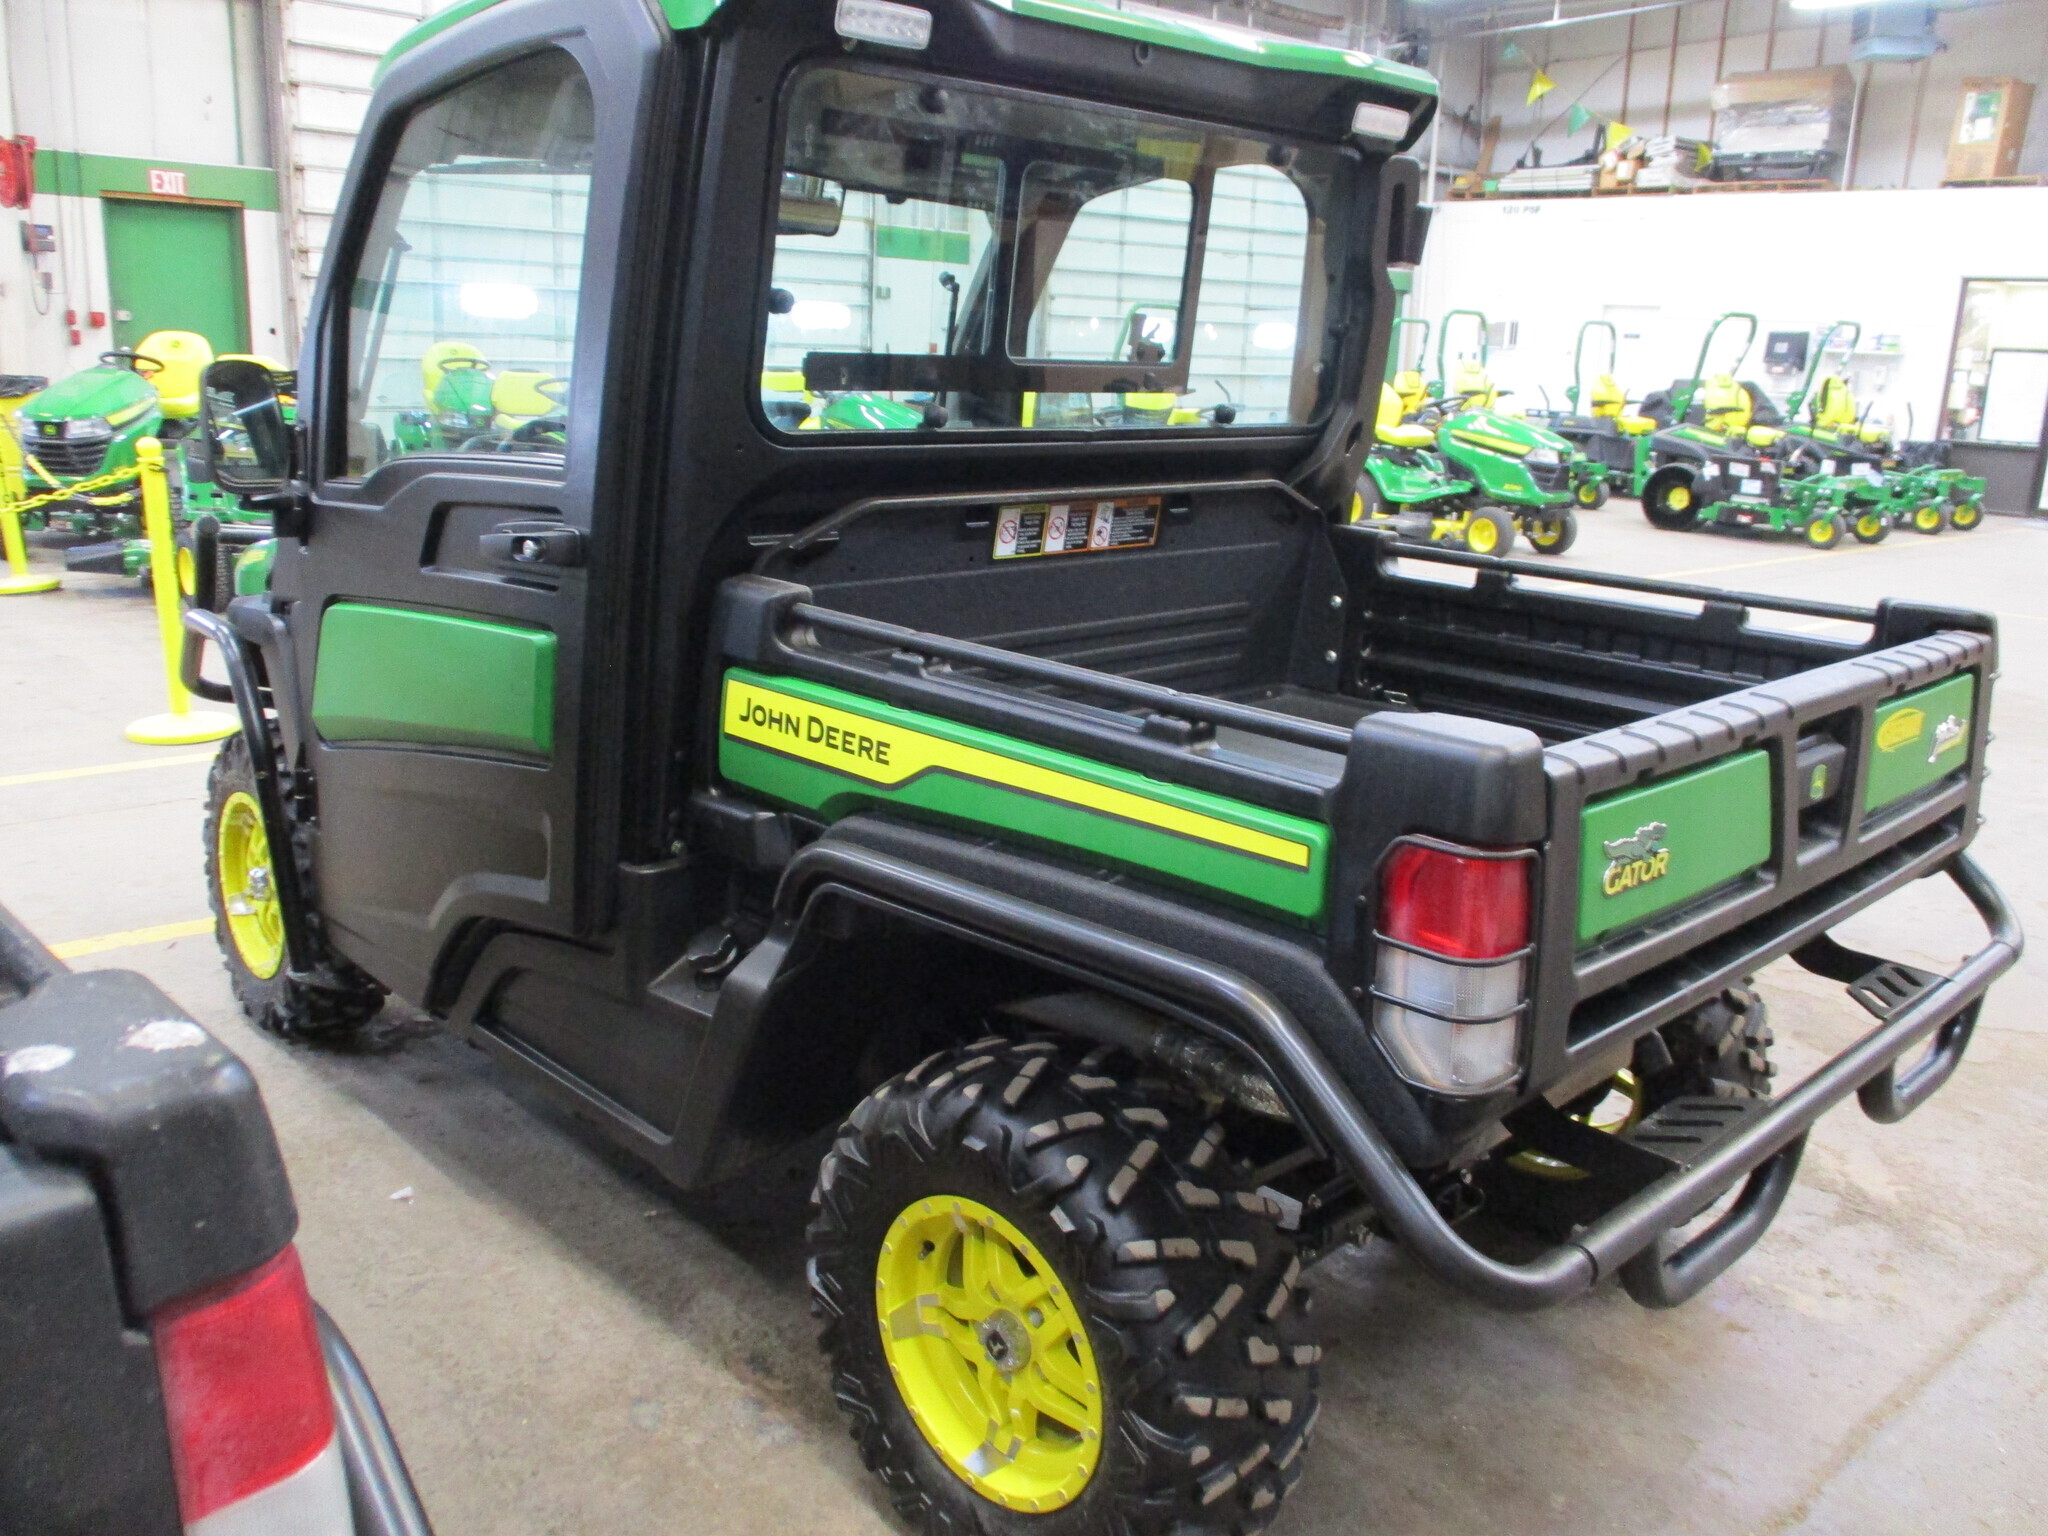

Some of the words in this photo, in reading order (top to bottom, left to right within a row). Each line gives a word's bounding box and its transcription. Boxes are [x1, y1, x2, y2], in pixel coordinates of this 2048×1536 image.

[150, 169, 186, 195] EXIT
[739, 697, 800, 738] JOHN
[807, 715, 891, 766] DEERE
[1604, 851, 1670, 895] GATOR
